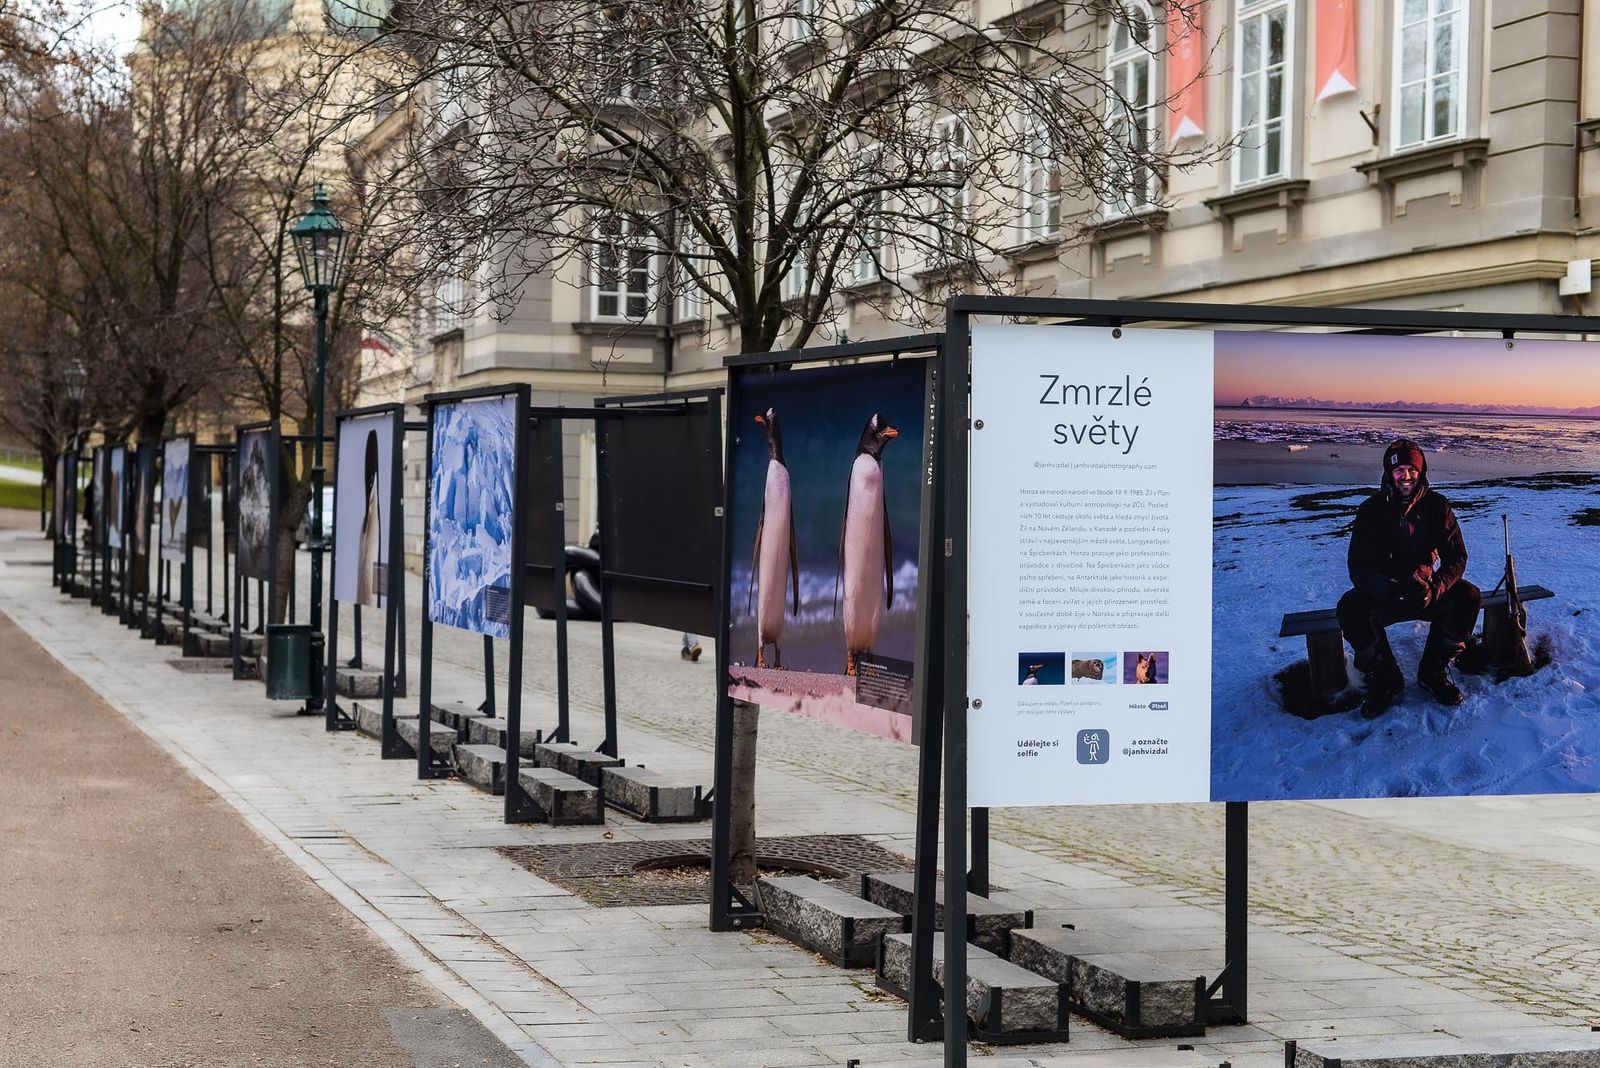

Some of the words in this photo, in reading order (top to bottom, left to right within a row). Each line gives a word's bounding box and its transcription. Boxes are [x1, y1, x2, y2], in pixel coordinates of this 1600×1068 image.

[1039, 373, 1152, 407] Zmrzlé
[1053, 414, 1139, 455] světy
[1017, 740, 1050, 748] Udělejte
[1123, 748, 1168, 756] @janhvizdal
